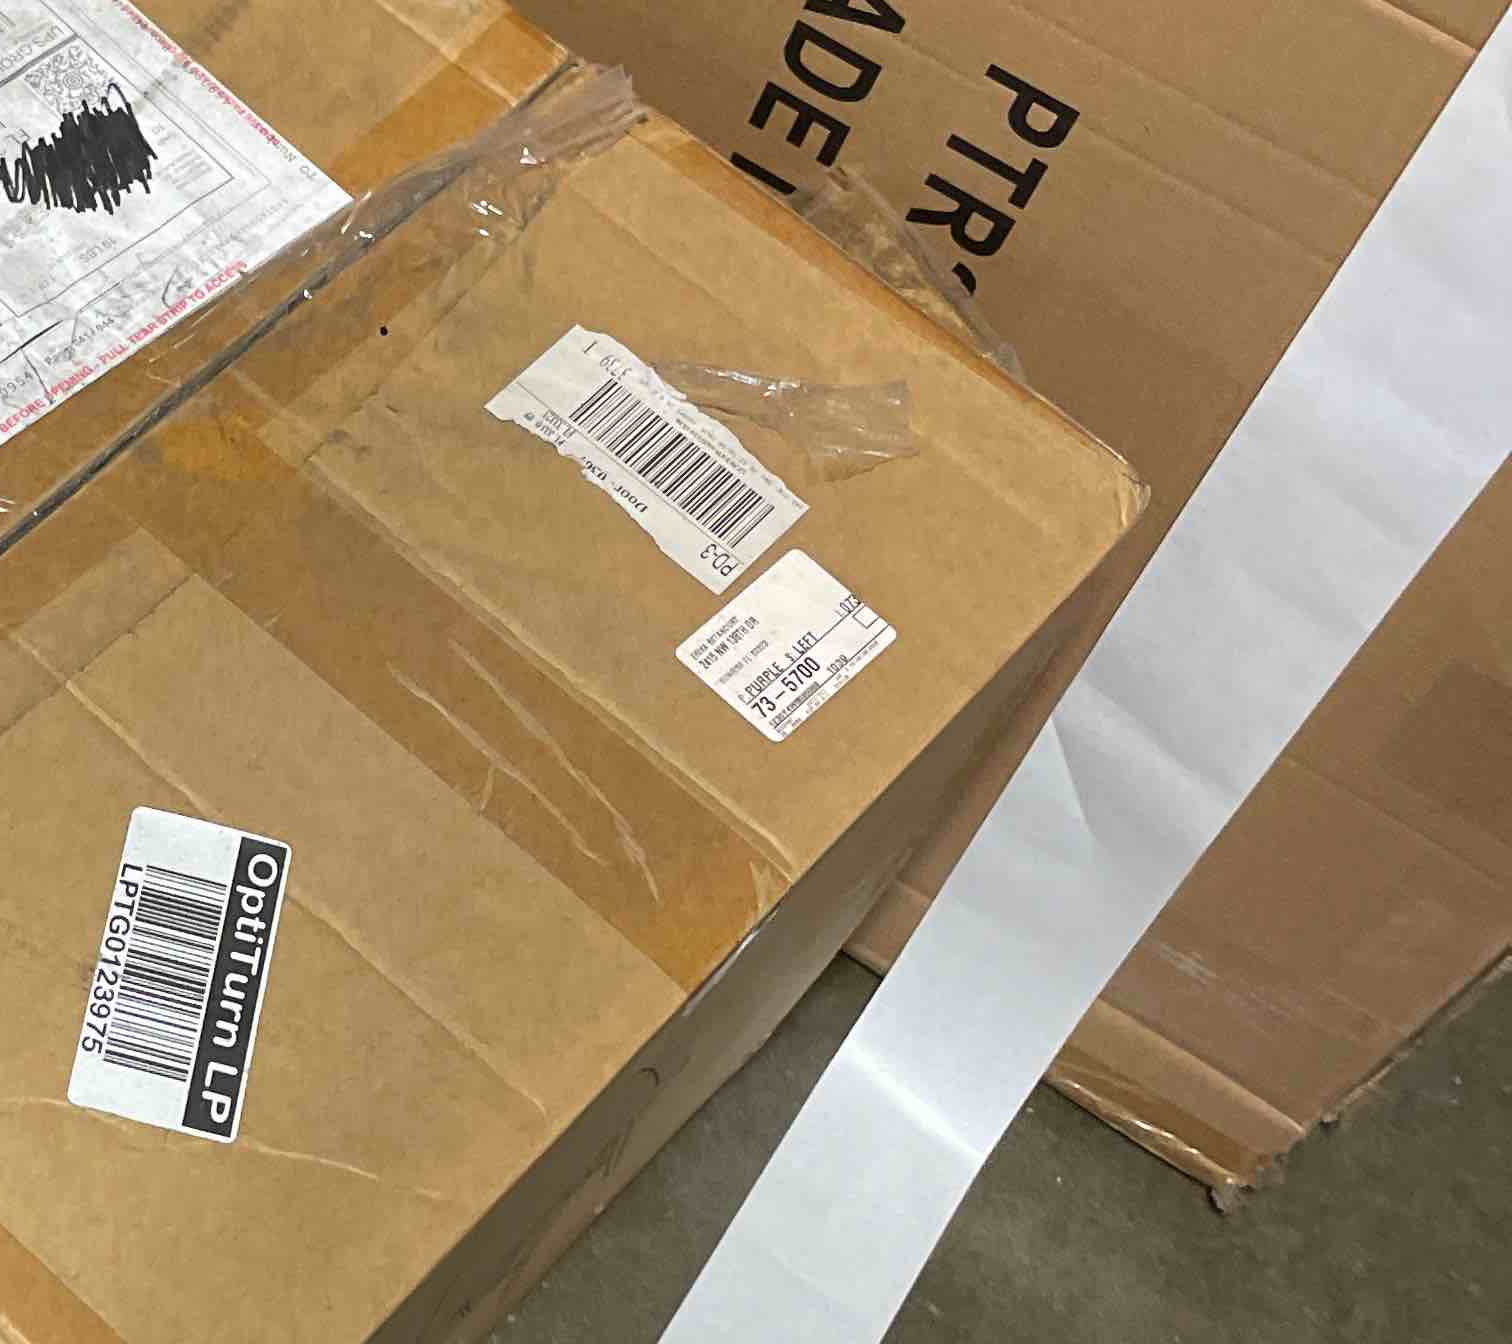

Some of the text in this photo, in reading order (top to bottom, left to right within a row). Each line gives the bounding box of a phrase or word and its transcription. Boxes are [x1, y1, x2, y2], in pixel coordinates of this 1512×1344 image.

[97, 339, 129, 367] PULL
[696, 540, 741, 578] PD-3
[743, 660, 785, 697] PURPLE
[791, 630, 818, 655] LEFT
[81, 861, 144, 1055] LPTG0123975
[200, 852, 280, 1126] OptiTurn LP
